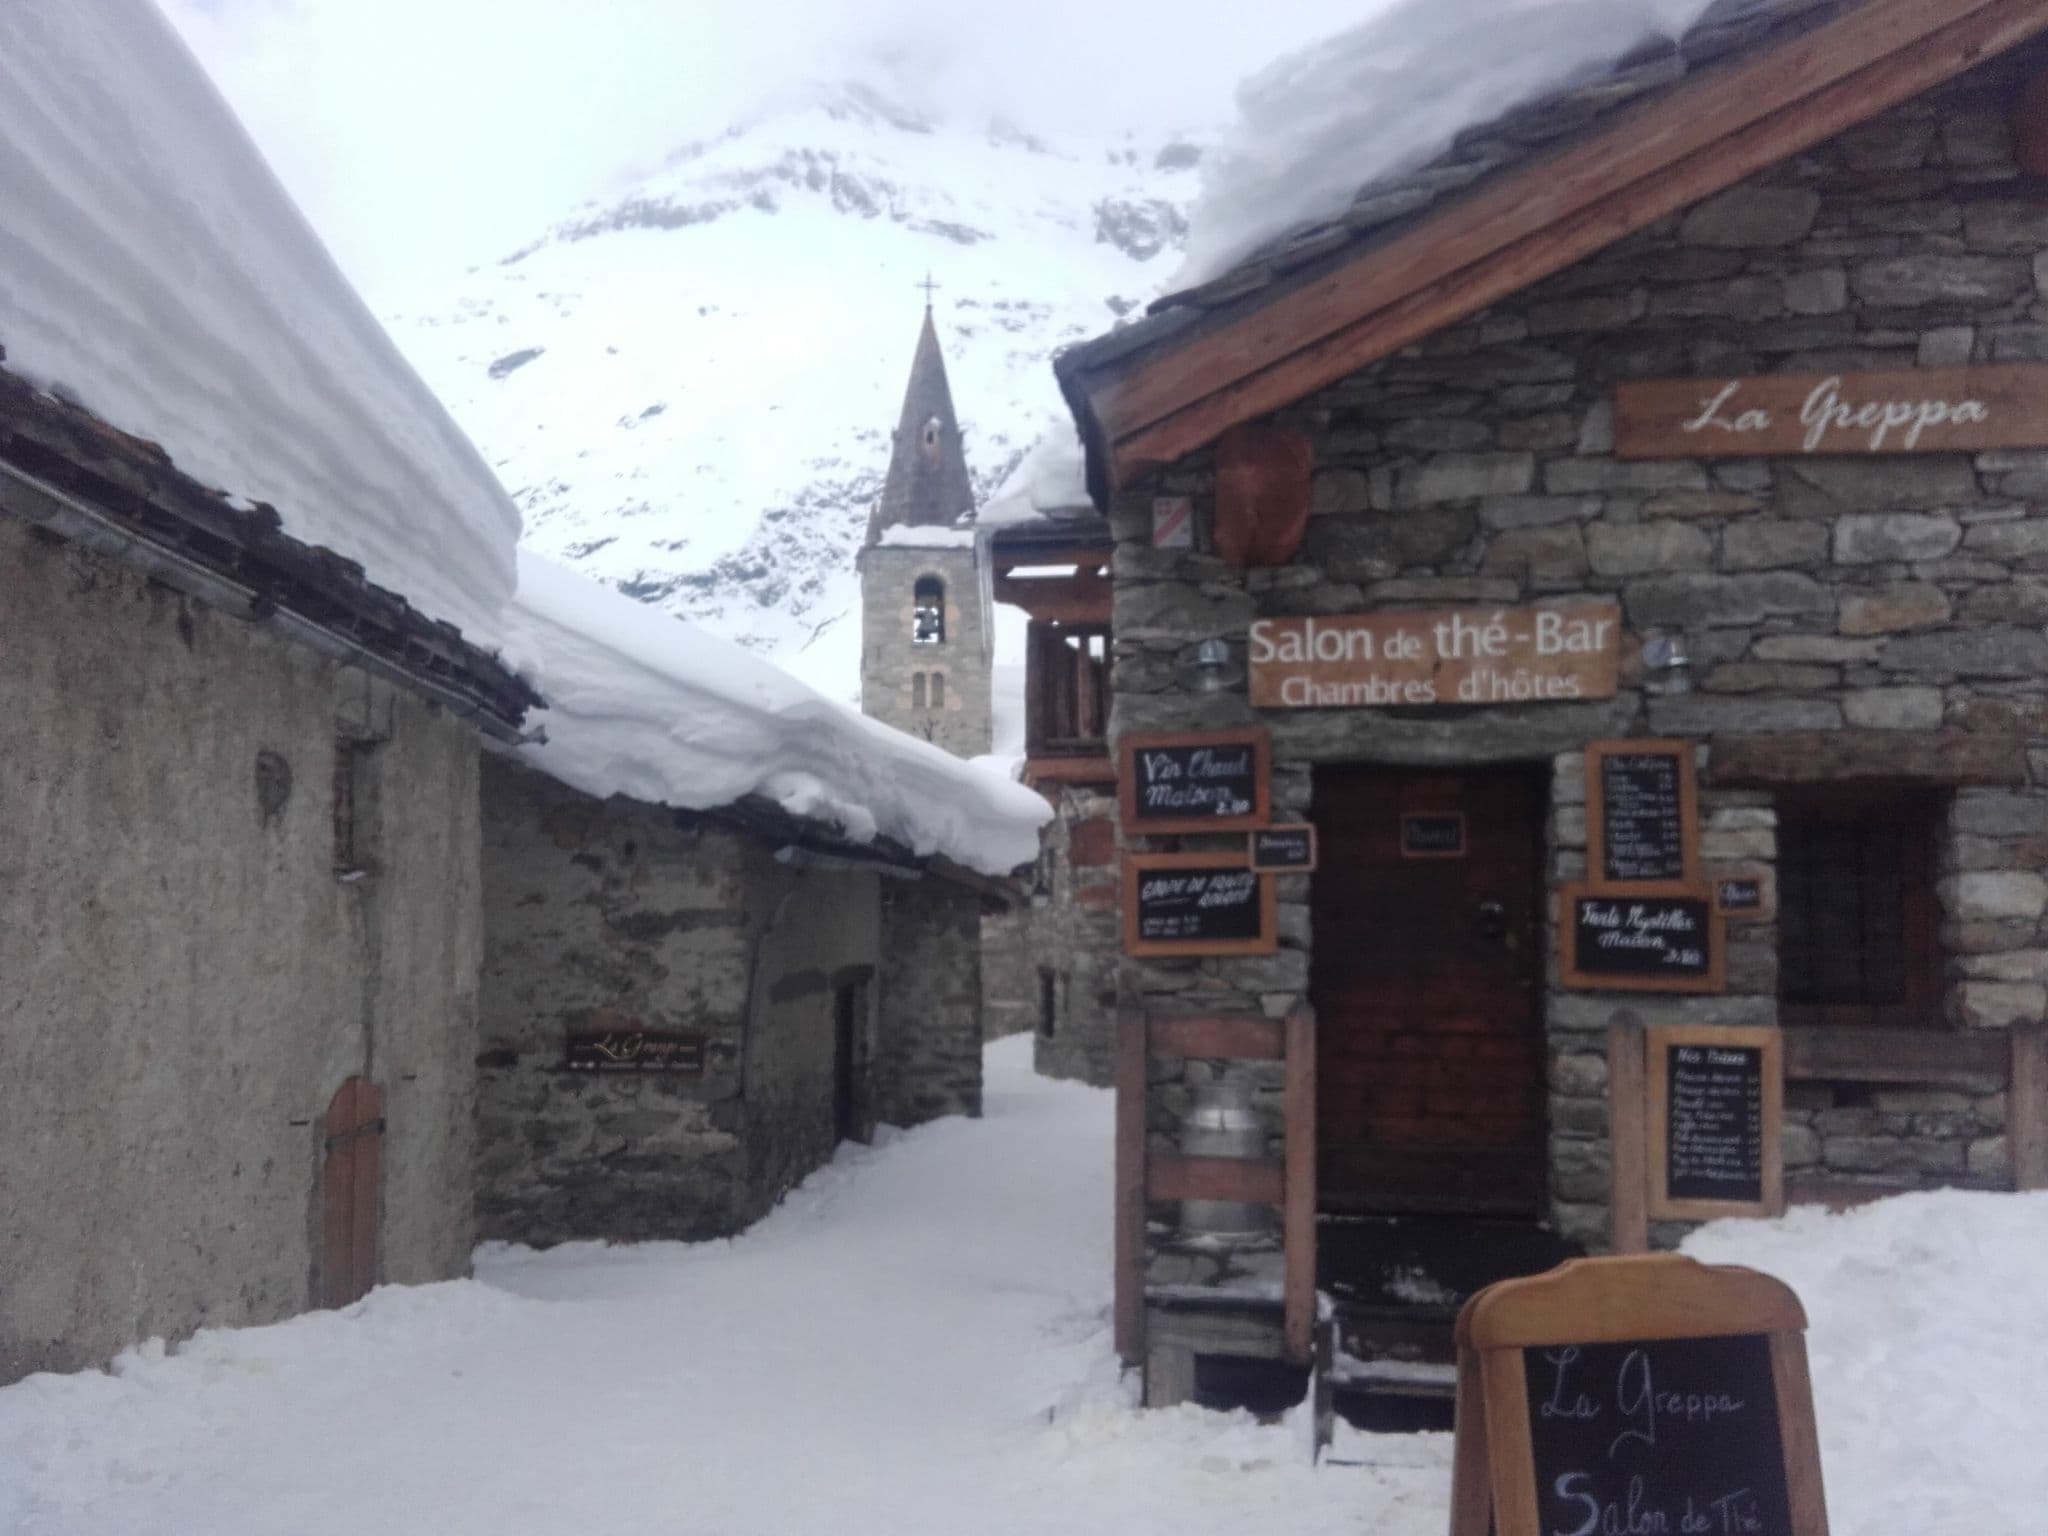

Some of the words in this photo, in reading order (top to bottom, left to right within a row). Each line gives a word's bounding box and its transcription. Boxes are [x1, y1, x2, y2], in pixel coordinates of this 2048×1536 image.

[1684, 379, 1771, 432] La
[1800, 375, 1989, 451] Greppa
[1249, 616, 1373, 664] Salon
[1383, 629, 1422, 660] de
[1281, 675, 1436, 706] Chambres
[1458, 668, 1581, 701] d'hôtes
[1144, 752, 1182, 783] Vin
[1188, 748, 1249, 778] Chaud
[1146, 783, 1234, 807] Maison
[1541, 1347, 1601, 1418] La
[1609, 1349, 1745, 1459] Greppa
[1553, 1471, 1666, 1536] Salon
[1680, 1496, 1711, 1529] de
